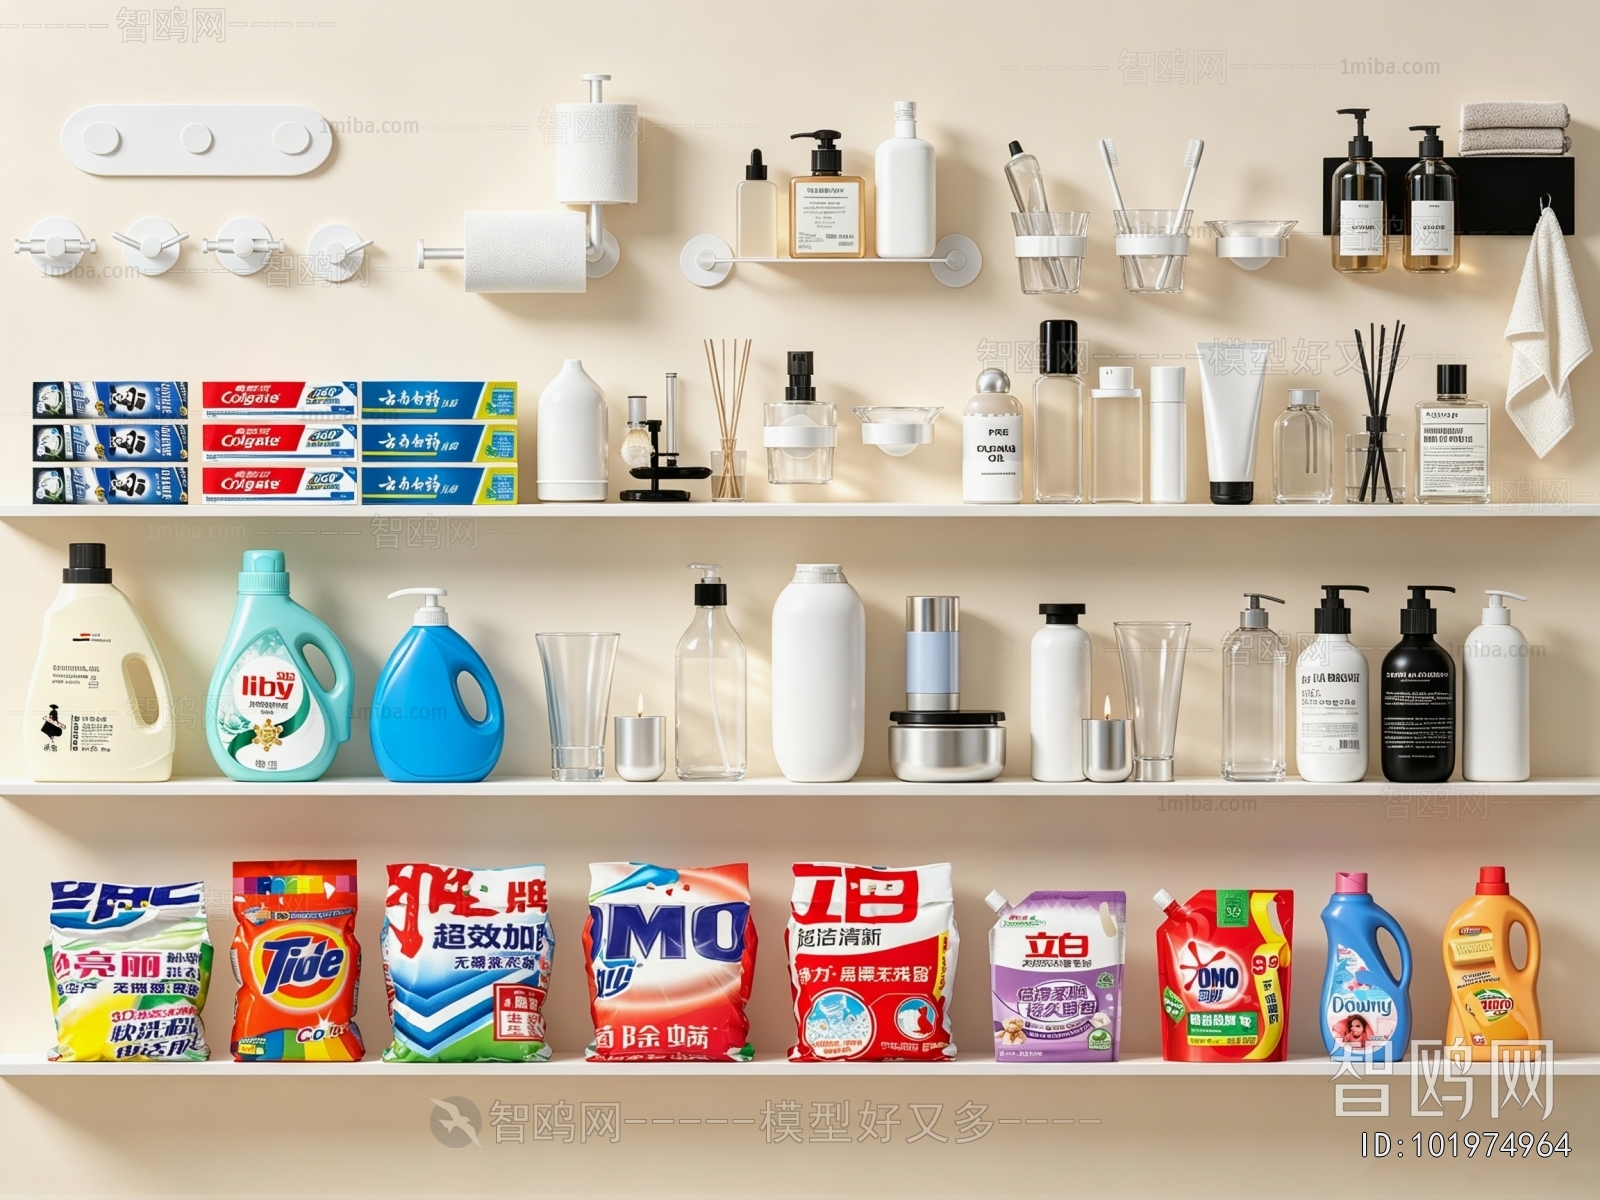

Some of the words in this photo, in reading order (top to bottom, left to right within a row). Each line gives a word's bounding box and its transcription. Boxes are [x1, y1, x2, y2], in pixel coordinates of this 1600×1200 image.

[221, 391, 280, 405] Colgate
[221, 434, 280, 448] Colgate
[242, 675, 294, 700] liby
[1025, 932, 1089, 958] 立白
[261, 937, 344, 995] Tide
[1198, 967, 1239, 989] OMO
[1332, 996, 1392, 1016] Downy
